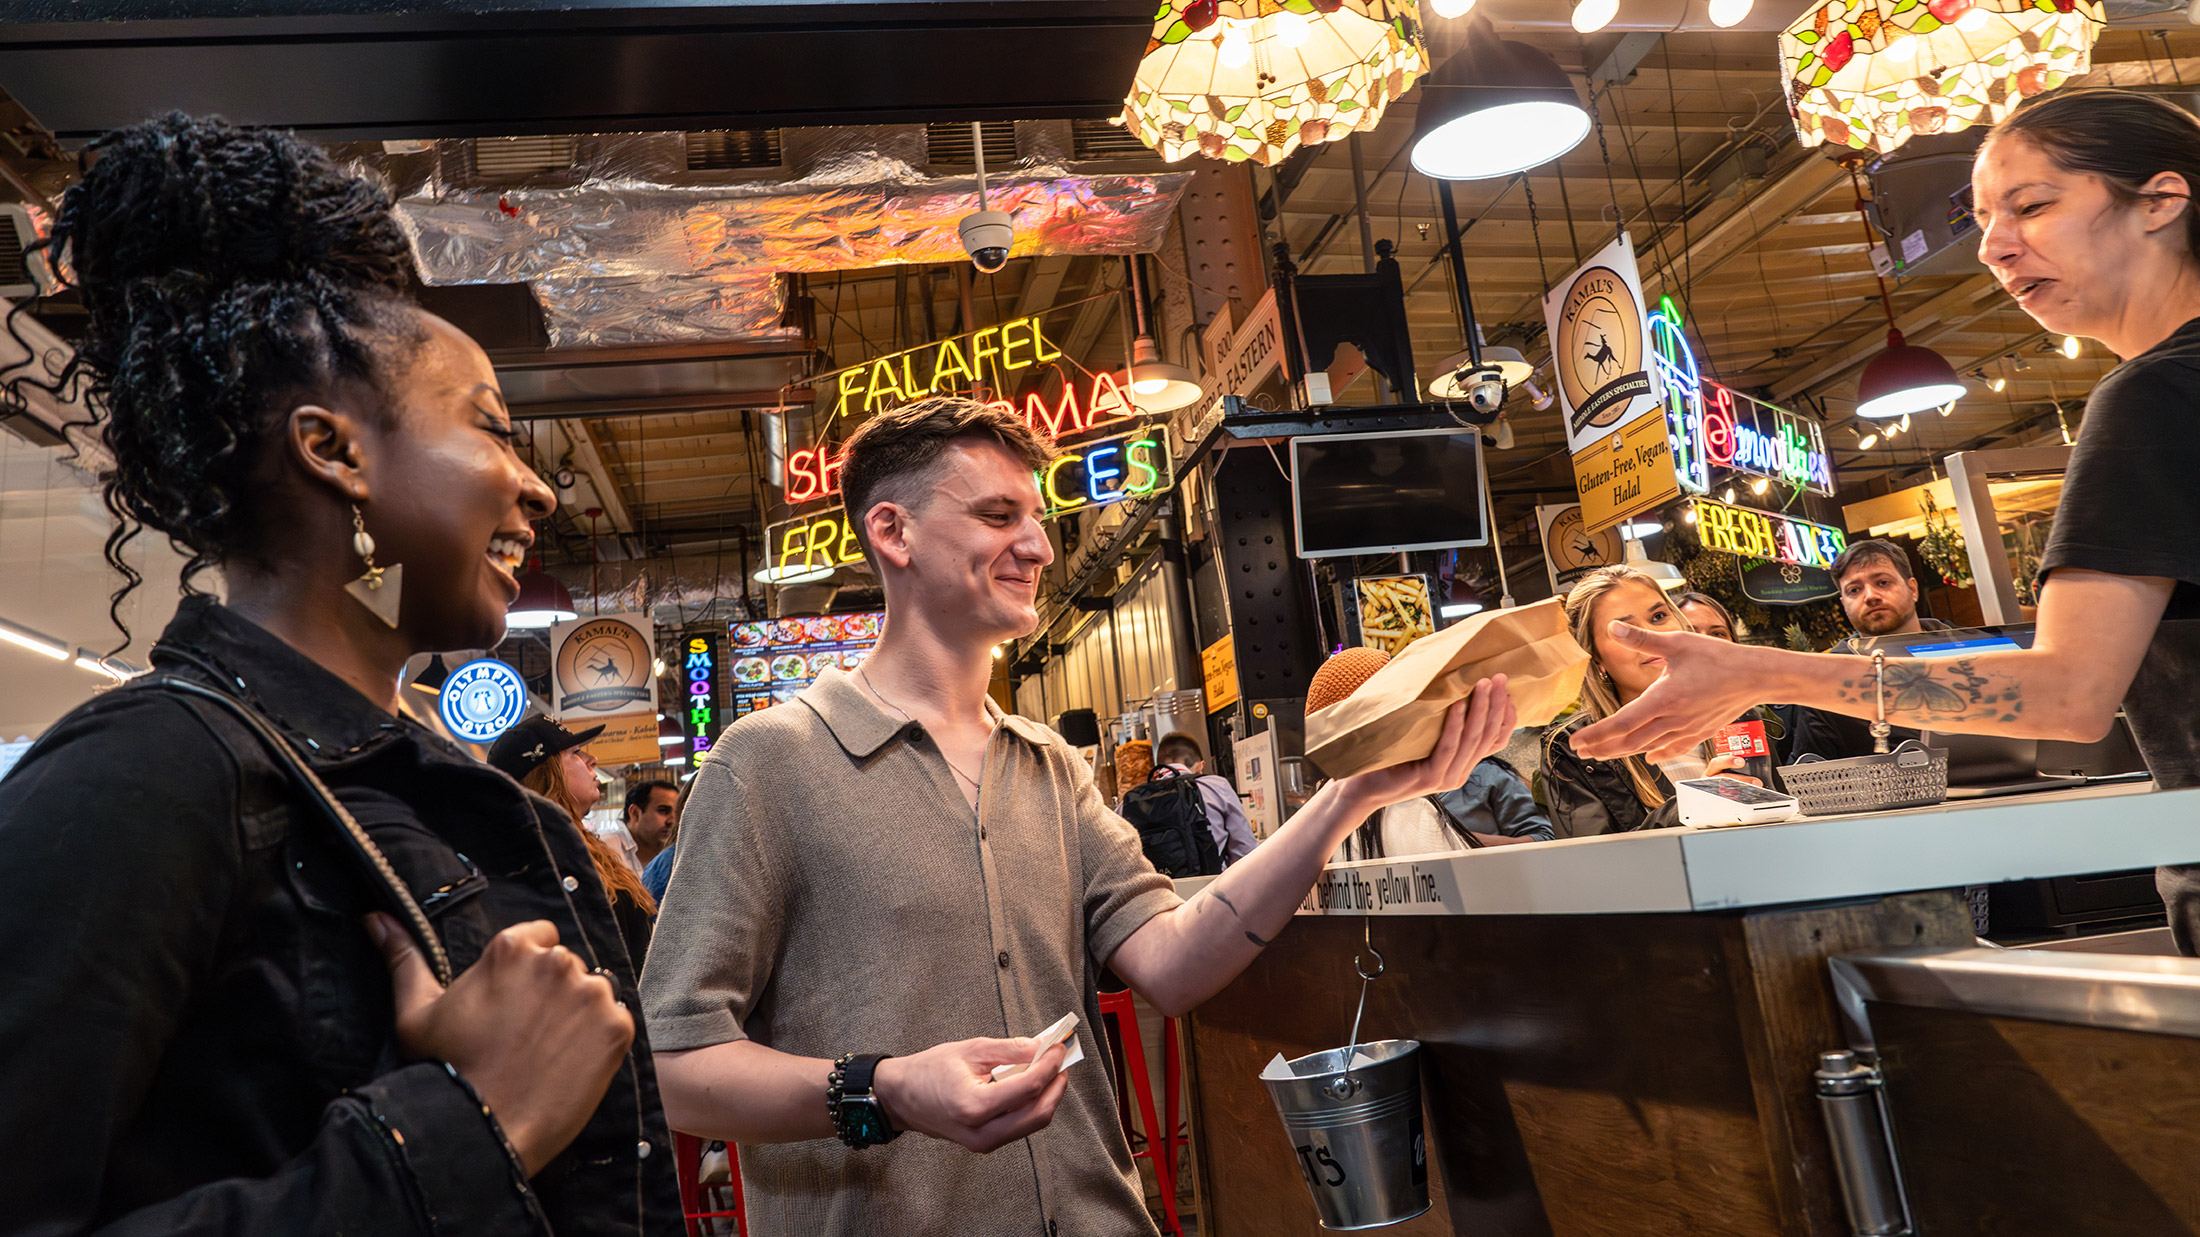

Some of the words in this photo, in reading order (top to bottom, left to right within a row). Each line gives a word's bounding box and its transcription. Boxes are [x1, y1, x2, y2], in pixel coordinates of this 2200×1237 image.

[1566, 279, 1614, 324] KAMAL'S
[838, 317, 1062, 417] FALAFEL
[1217, 331, 1232, 364] 800
[1227, 318, 1277, 395] EASTERN
[1573, 406, 1592, 430] MIDDLE
[1591, 389, 1615, 411] EASTERN
[1613, 380, 1649, 396] SPECIALTIES
[1702, 387, 1829, 486] Smoothies
[1579, 457, 1636, 494] Gluten-Free,
[1635, 441, 1669, 467] Vegan,
[1613, 475, 1641, 507] Halal
[1694, 502, 1777, 559] FRESH
[574, 626, 631, 645] KAMAL'S
[449, 667, 516, 703] OLYMPIA
[685, 637, 713, 768] SMOOTHIES
[461, 715, 507, 735] GYRO
[1316, 872, 1352, 910] behind
[1352, 871, 1373, 910] the
[1375, 867, 1410, 911] yellow
[1411, 864, 1442, 903] line.
[1297, 1145, 1346, 1187] TS
